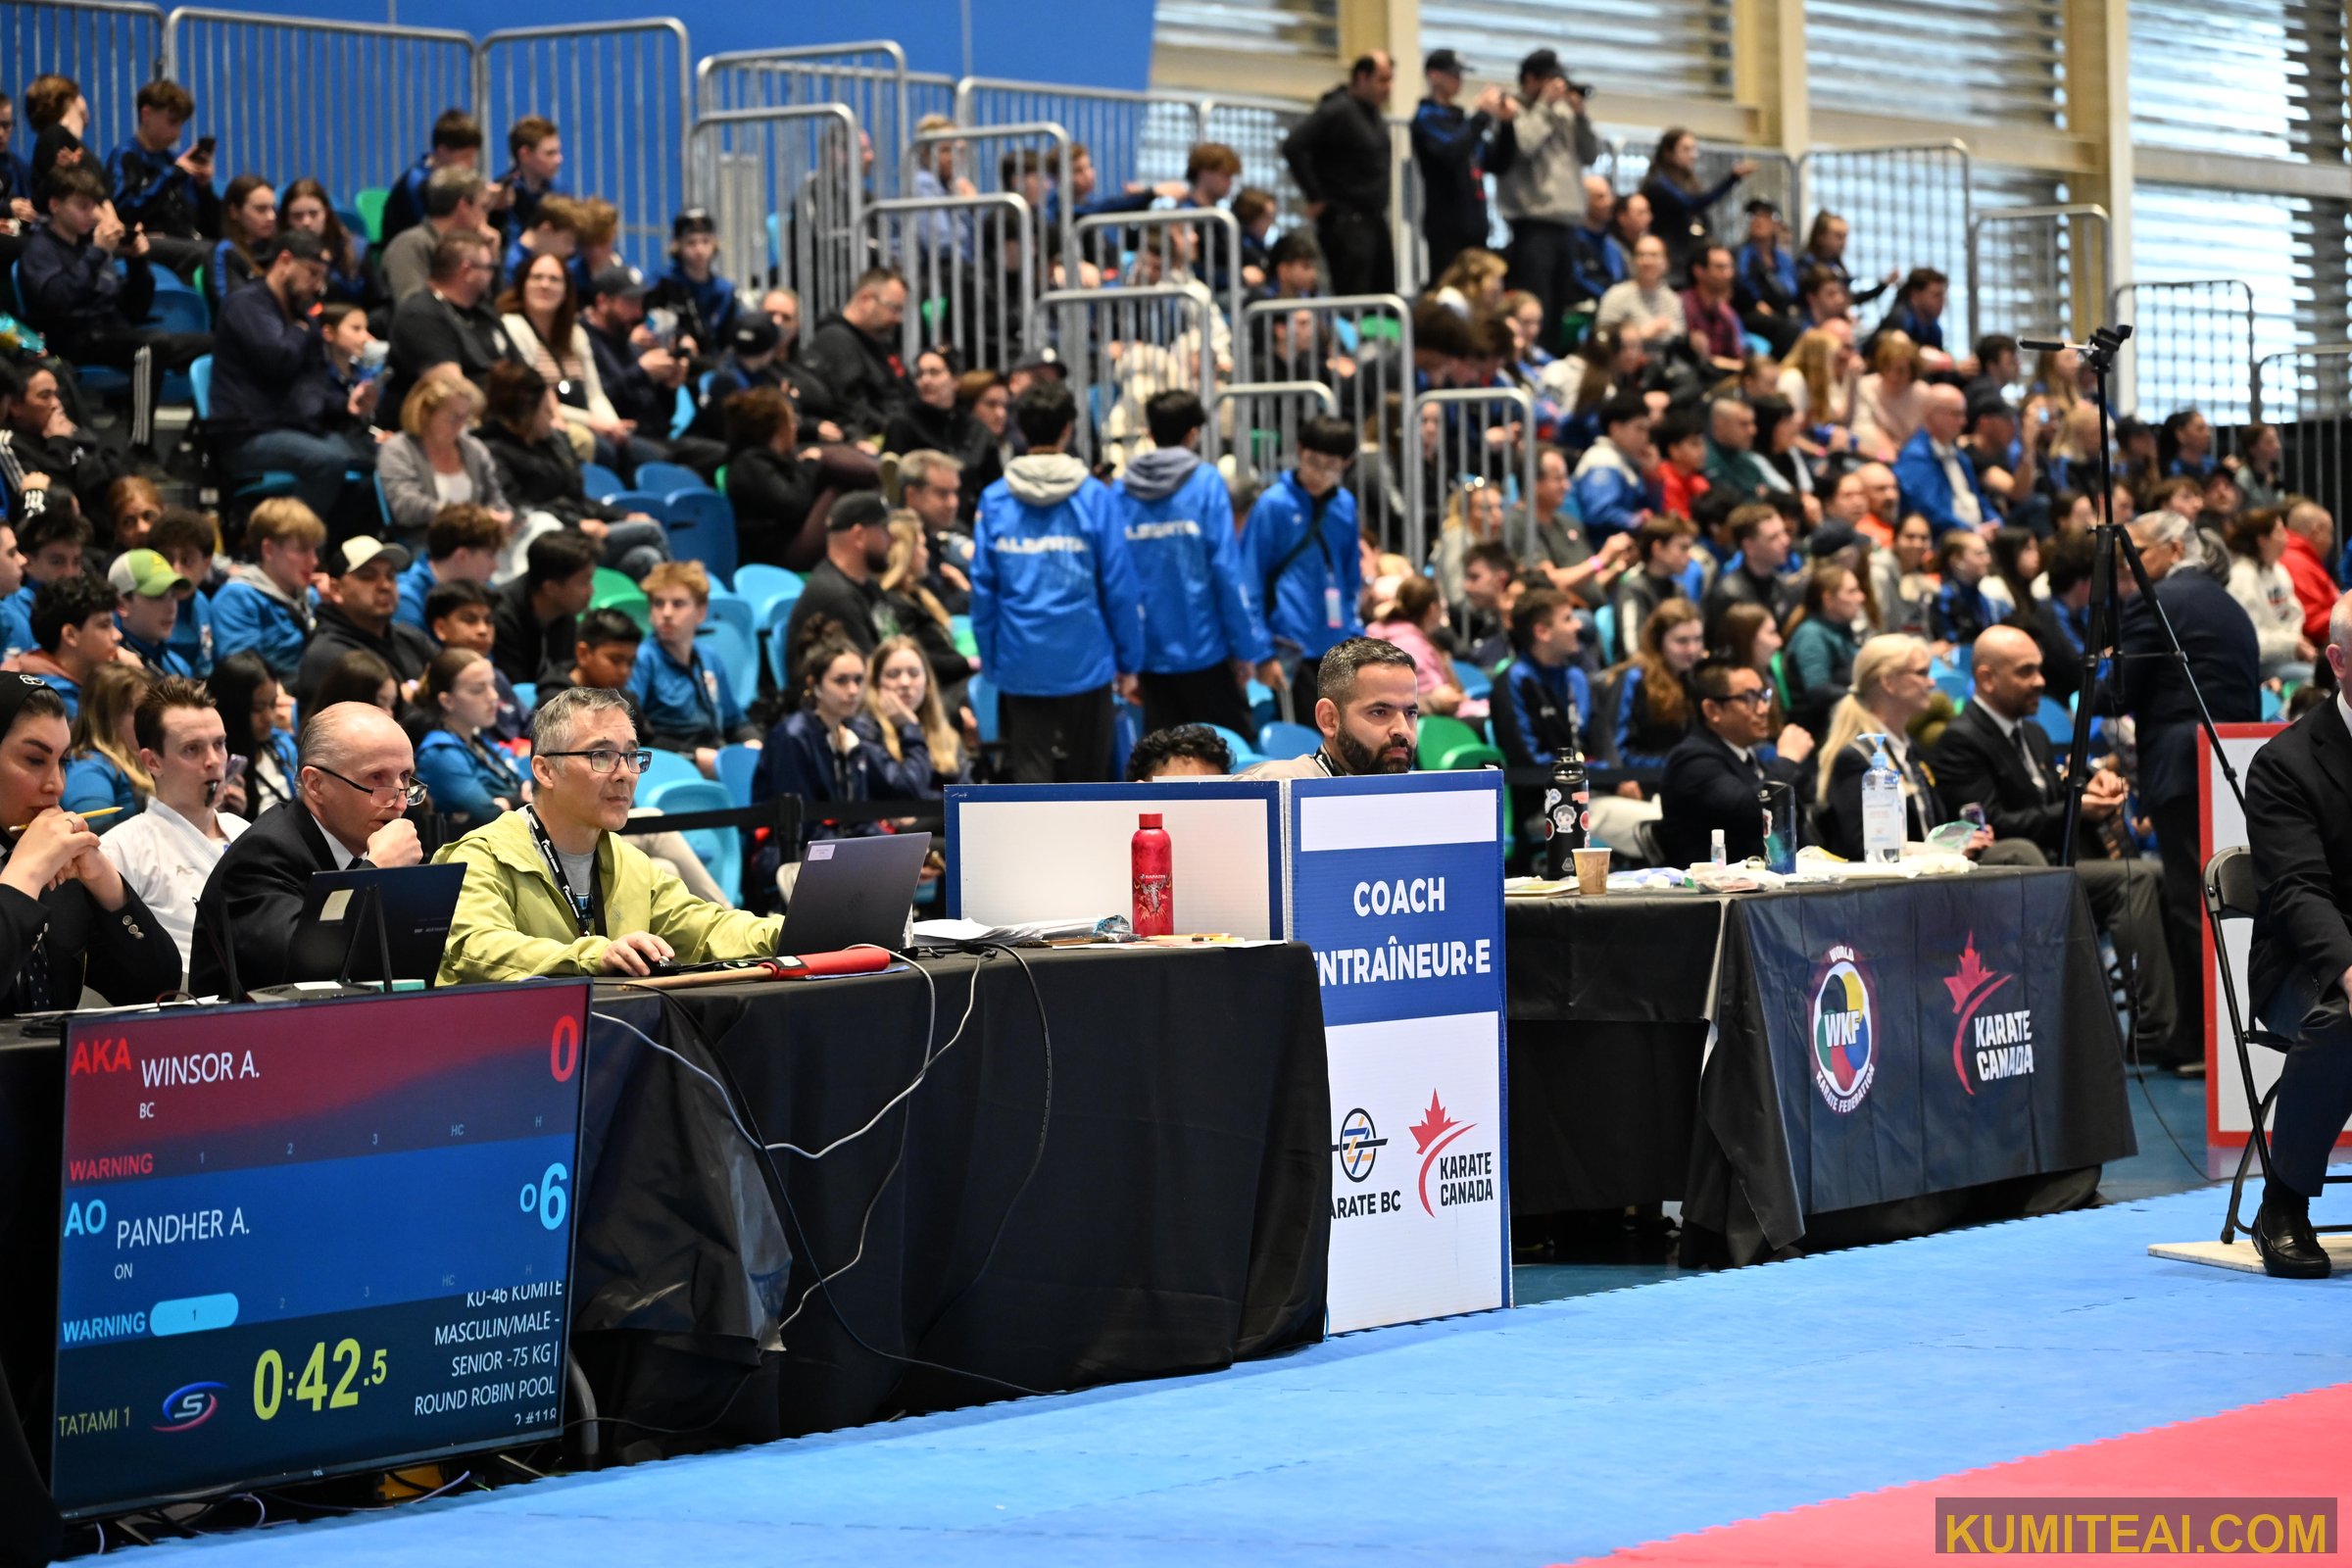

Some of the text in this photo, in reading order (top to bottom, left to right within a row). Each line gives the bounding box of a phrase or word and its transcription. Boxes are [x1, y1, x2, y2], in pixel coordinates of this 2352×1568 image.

[1353, 877, 1445, 917] COACH
[1313, 936, 1491, 987] NTRAÎNEUR·E
[1829, 945, 1854, 962] WORLD
[1824, 1010, 1861, 1048] WKF
[1975, 1009, 2033, 1048] KARATE
[71, 1038, 132, 1077] AKA
[551, 1014, 578, 1083] 0
[1977, 1044, 2034, 1081] CANADA
[141, 1050, 261, 1088] WINSOR A.
[1816, 1063, 1875, 1113] KARATE FEDERATION
[139, 1102, 155, 1119] BC
[70, 1116, 542, 1182] WARNING 1 2 3 HC H
[1440, 1152, 1492, 1180] KARATE
[1381, 1190, 1401, 1213] BC
[1441, 1178, 1494, 1206] CANADA
[64, 1199, 107, 1238] AO
[117, 1206, 250, 1250] PANDHER A.
[115, 1263, 132, 1280] ON
[63, 1311, 145, 1343] WARNING
[192, 1309, 197, 1322] 1
[364, 1286, 370, 1298] 3
[442, 1274, 455, 1287] HC
[466, 1280, 563, 1308] KU-46 KUMITE
[434, 1310, 551, 1347] MASCULIN/MALE
[451, 1350, 503, 1377] SENIOR
[507, 1347, 528, 1367] -75
[532, 1343, 551, 1364] KG
[254, 1338, 387, 1421] 0:42.5
[415, 1375, 556, 1416] ROUND ROBIN POOL
[58, 1406, 130, 1438] TATAMI 1
